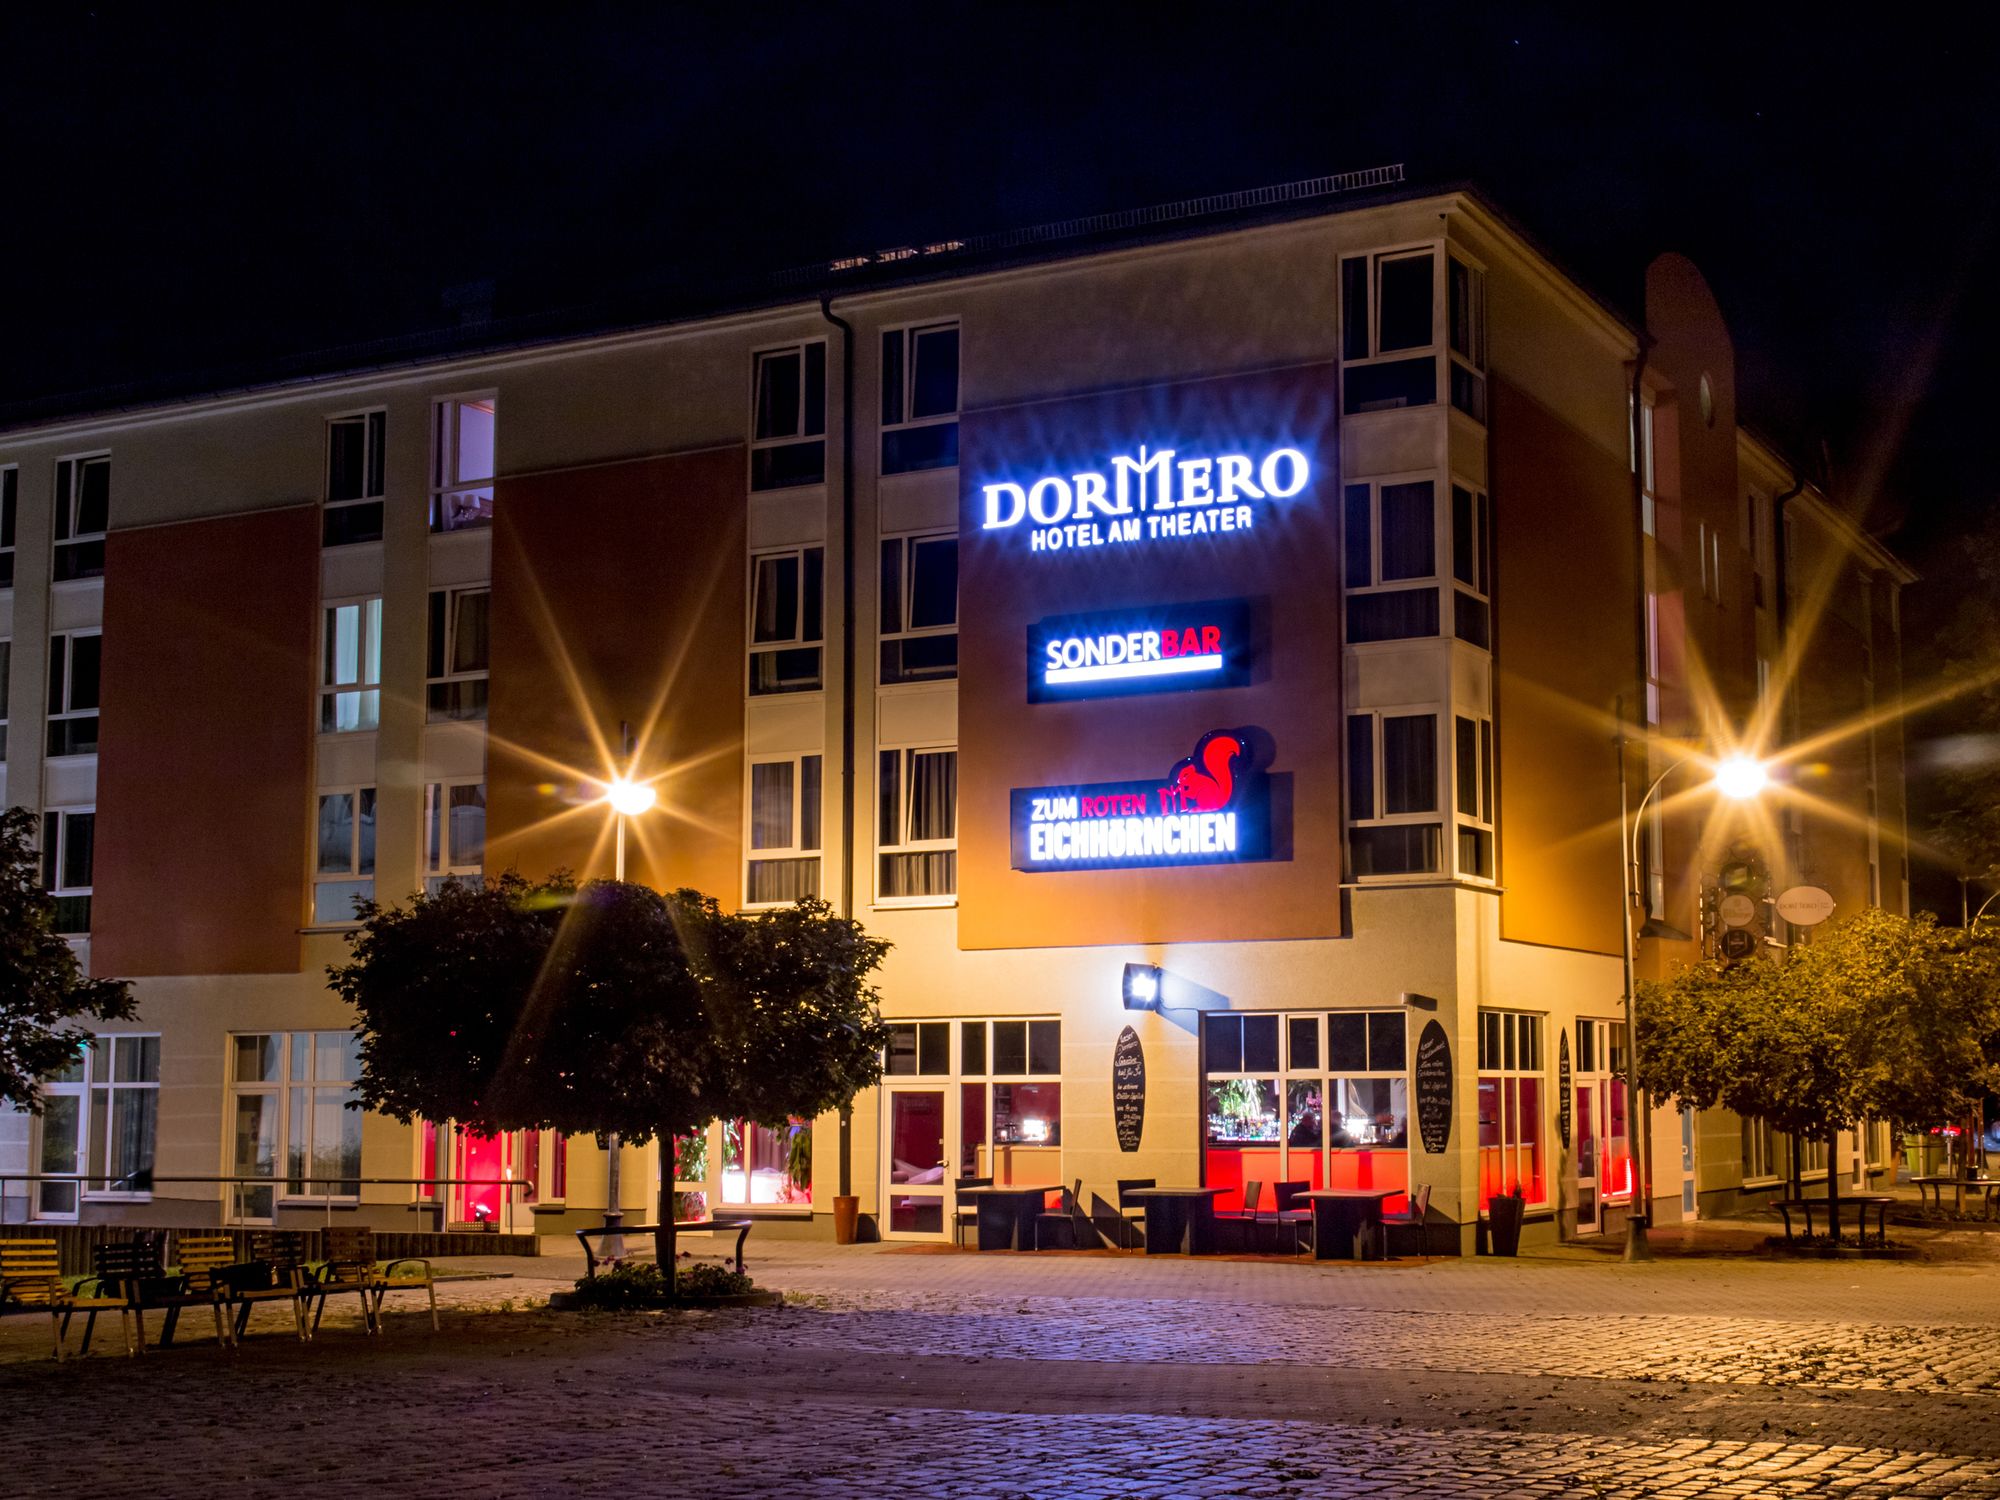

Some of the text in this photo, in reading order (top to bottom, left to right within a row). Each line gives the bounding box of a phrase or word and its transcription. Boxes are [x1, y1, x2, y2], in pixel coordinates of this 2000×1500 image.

[982, 444, 1309, 529] DORMERO
[1031, 506, 1252, 551] HOTEL AM THEATER
[1031, 793, 1147, 822] ZUM ROTEN
